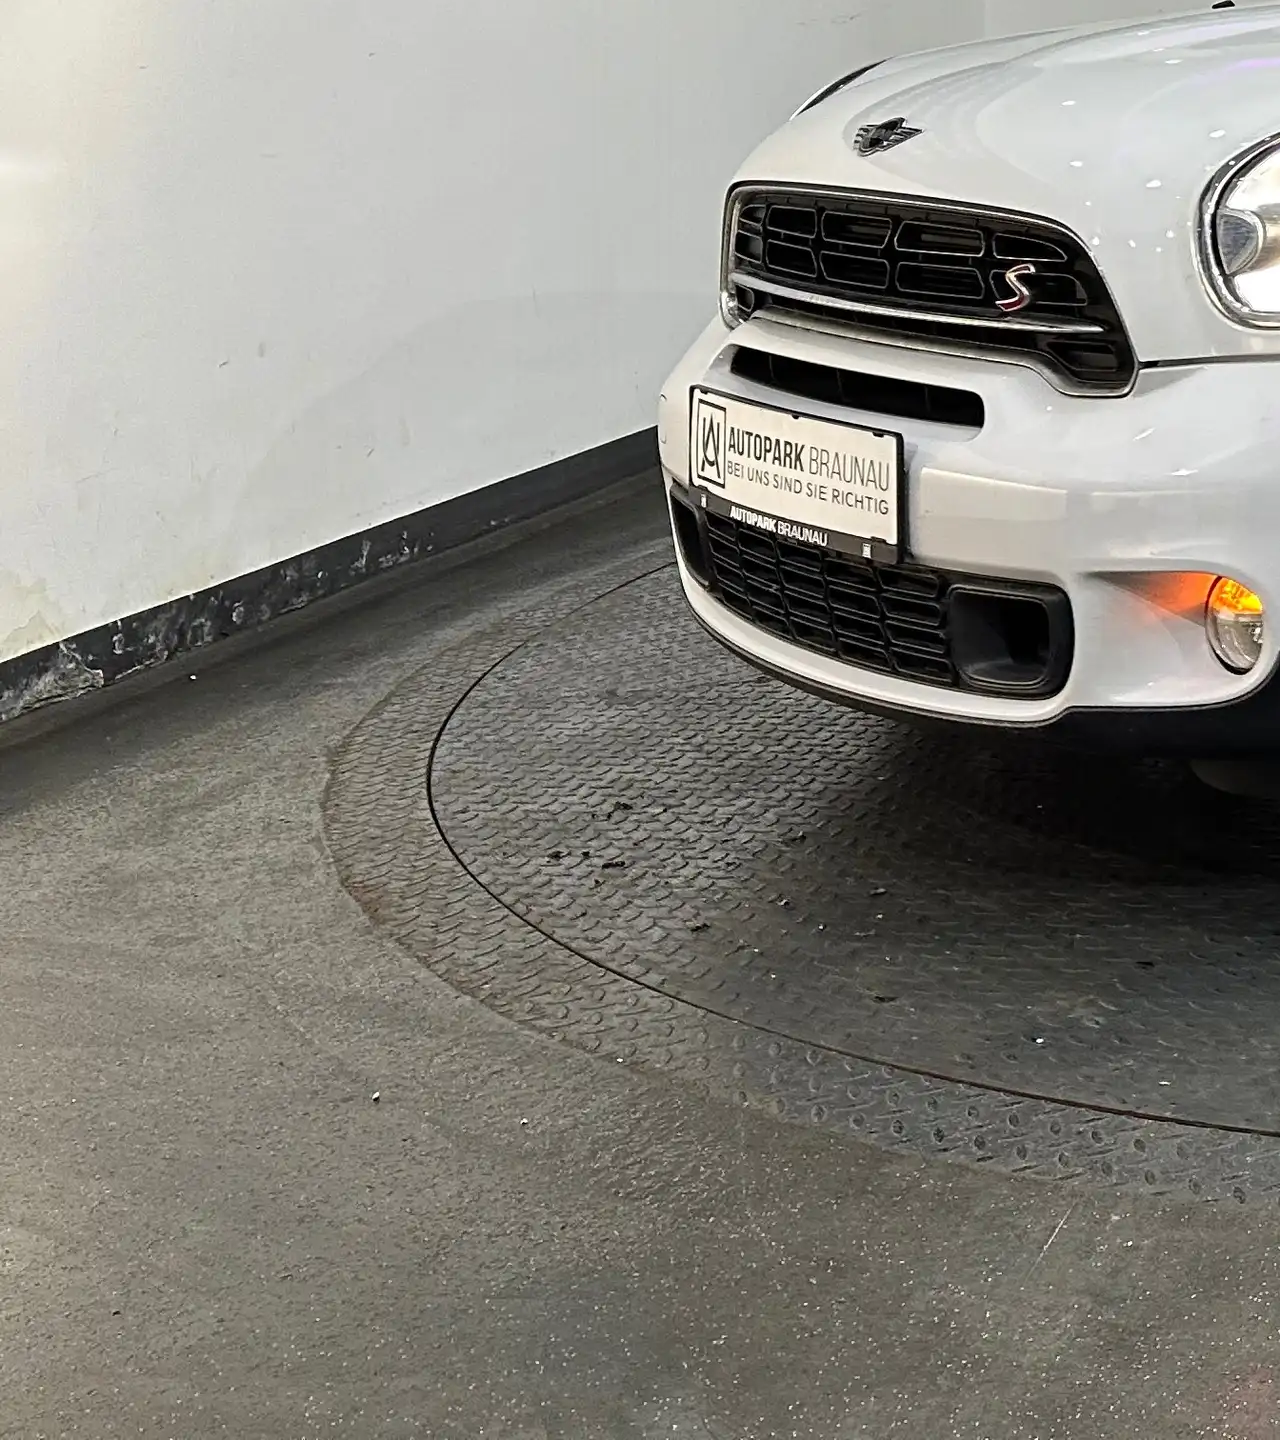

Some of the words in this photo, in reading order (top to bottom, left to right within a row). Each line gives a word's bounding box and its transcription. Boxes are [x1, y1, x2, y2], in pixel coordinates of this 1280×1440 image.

[727, 426, 806, 473] AUTOPARK
[808, 445, 890, 492] BRAUNAU
[727, 460, 745, 478] BEI
[746, 466, 770, 487] UNS
[772, 474, 803, 495] SIND
[805, 483, 828, 502] SIE
[831, 488, 890, 516] RICHTIG
[729, 505, 777, 534] AUTOPARK
[777, 520, 828, 547] BRAUNAU
